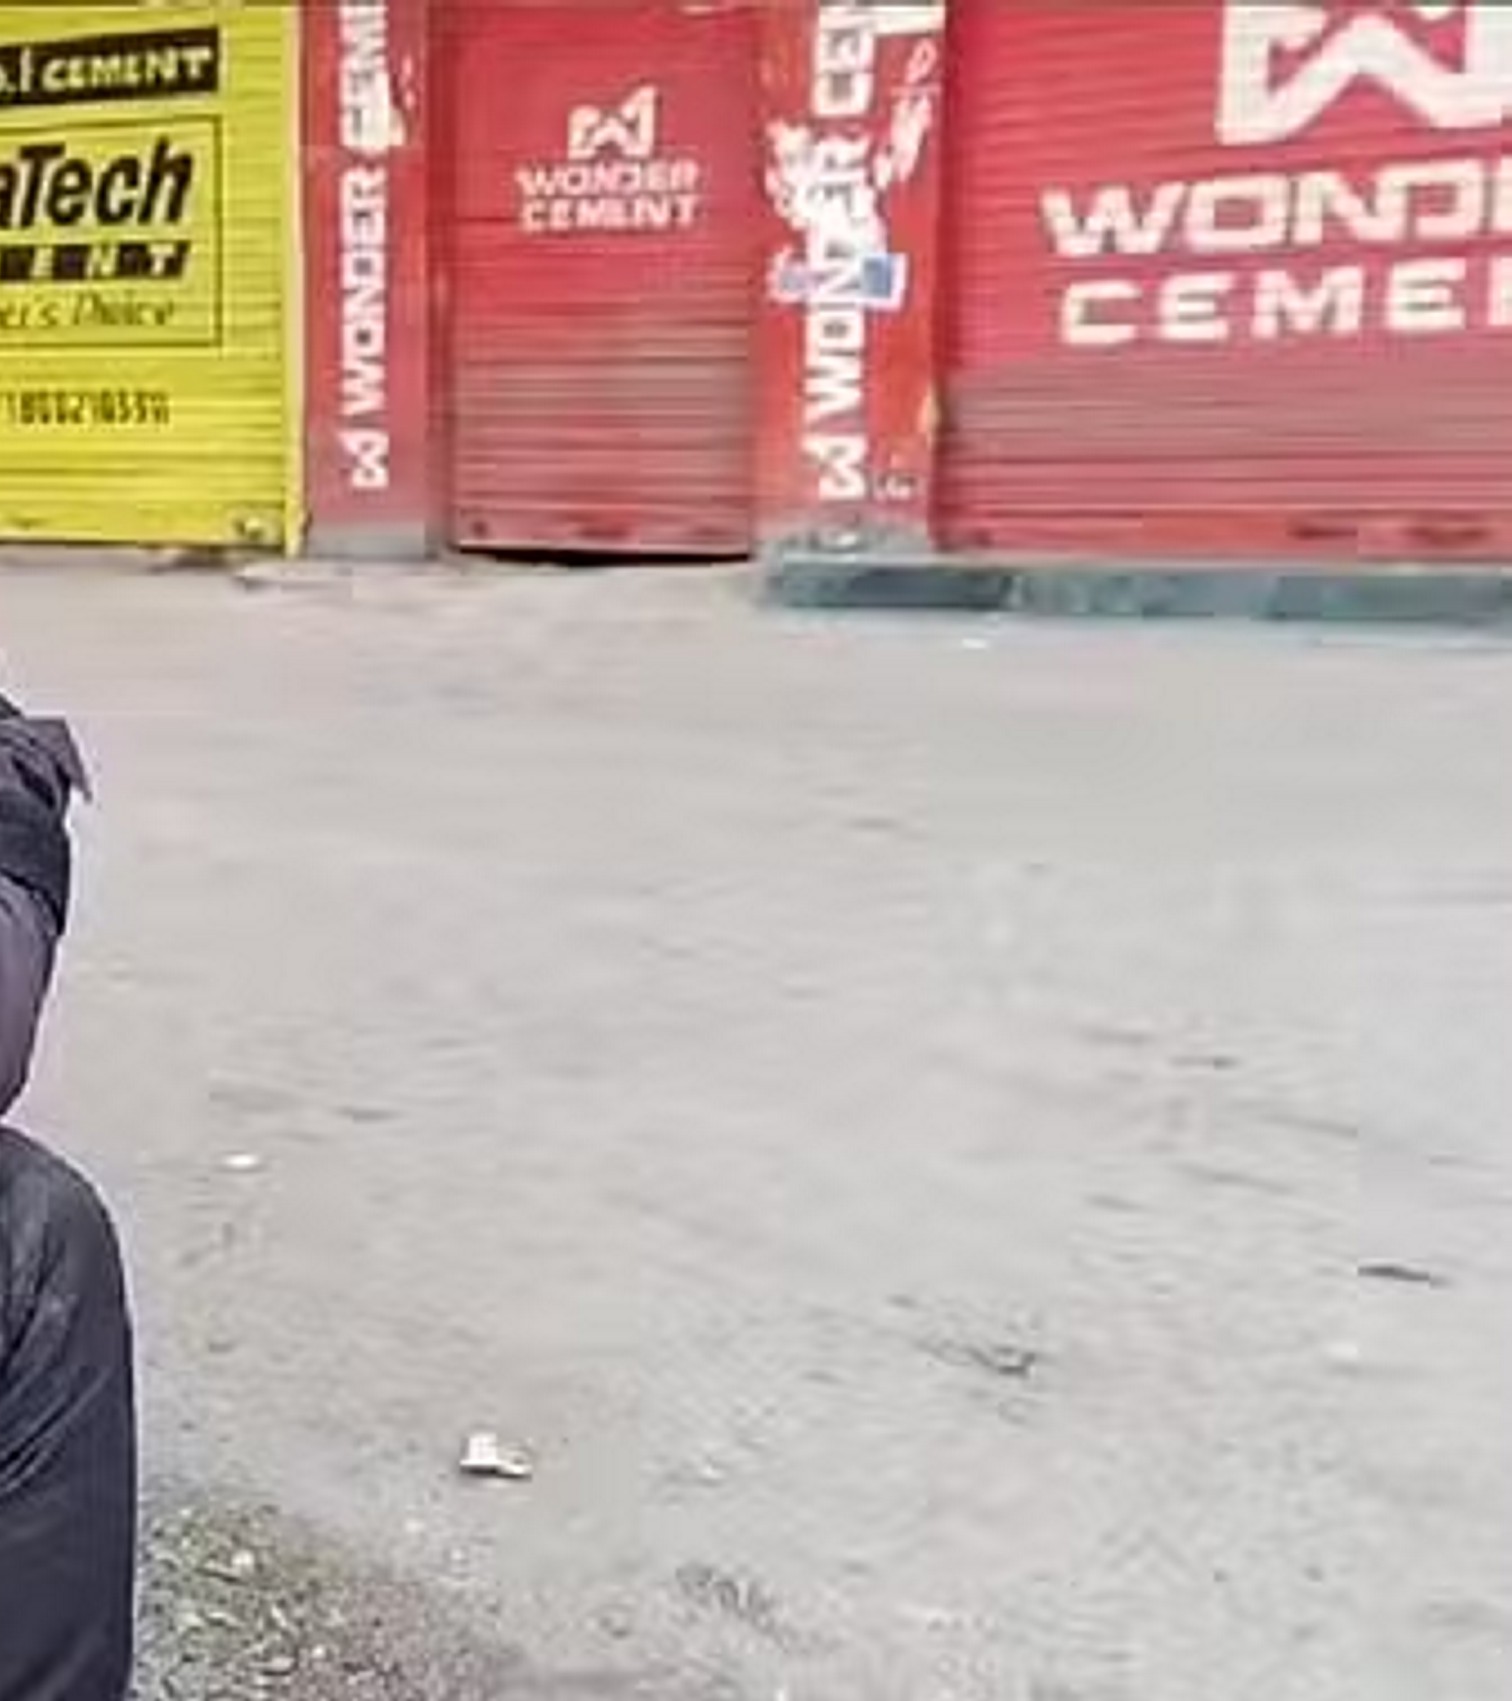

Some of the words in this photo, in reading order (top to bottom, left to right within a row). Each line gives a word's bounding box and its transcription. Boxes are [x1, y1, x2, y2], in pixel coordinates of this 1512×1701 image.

[40, 44, 212, 91] CEMENT
[339, 4, 389, 150] CEM
[514, 157, 700, 197] WONDER
[521, 195, 699, 232] CEMENT
[1040, 157, 1512, 257] WOND
[340, 167, 387, 415] WONDER
[801, 136, 870, 423] WONDER
[1060, 255, 1512, 346] CEME
